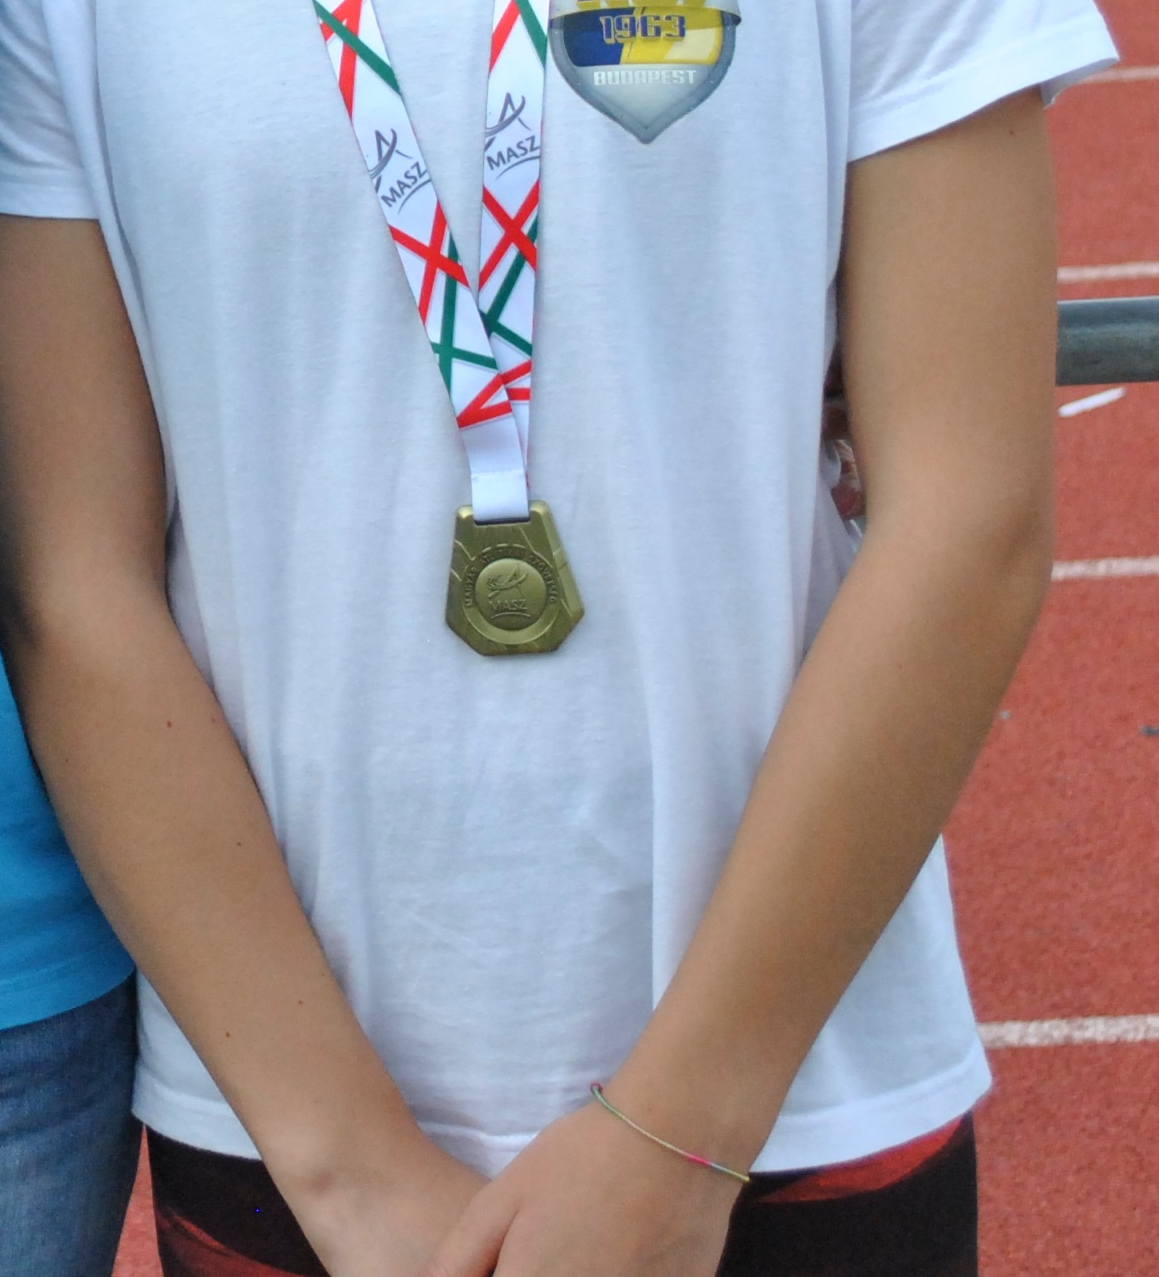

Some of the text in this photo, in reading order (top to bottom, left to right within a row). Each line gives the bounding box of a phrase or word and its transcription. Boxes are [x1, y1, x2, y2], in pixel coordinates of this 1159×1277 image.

[600, 14, 686, 44] 1963
[593, 69, 697, 86] BUDAPEST
[486, 135, 540, 171] MASZ
[381, 162, 428, 208] MASZ
[488, 599, 528, 612] MASZ
